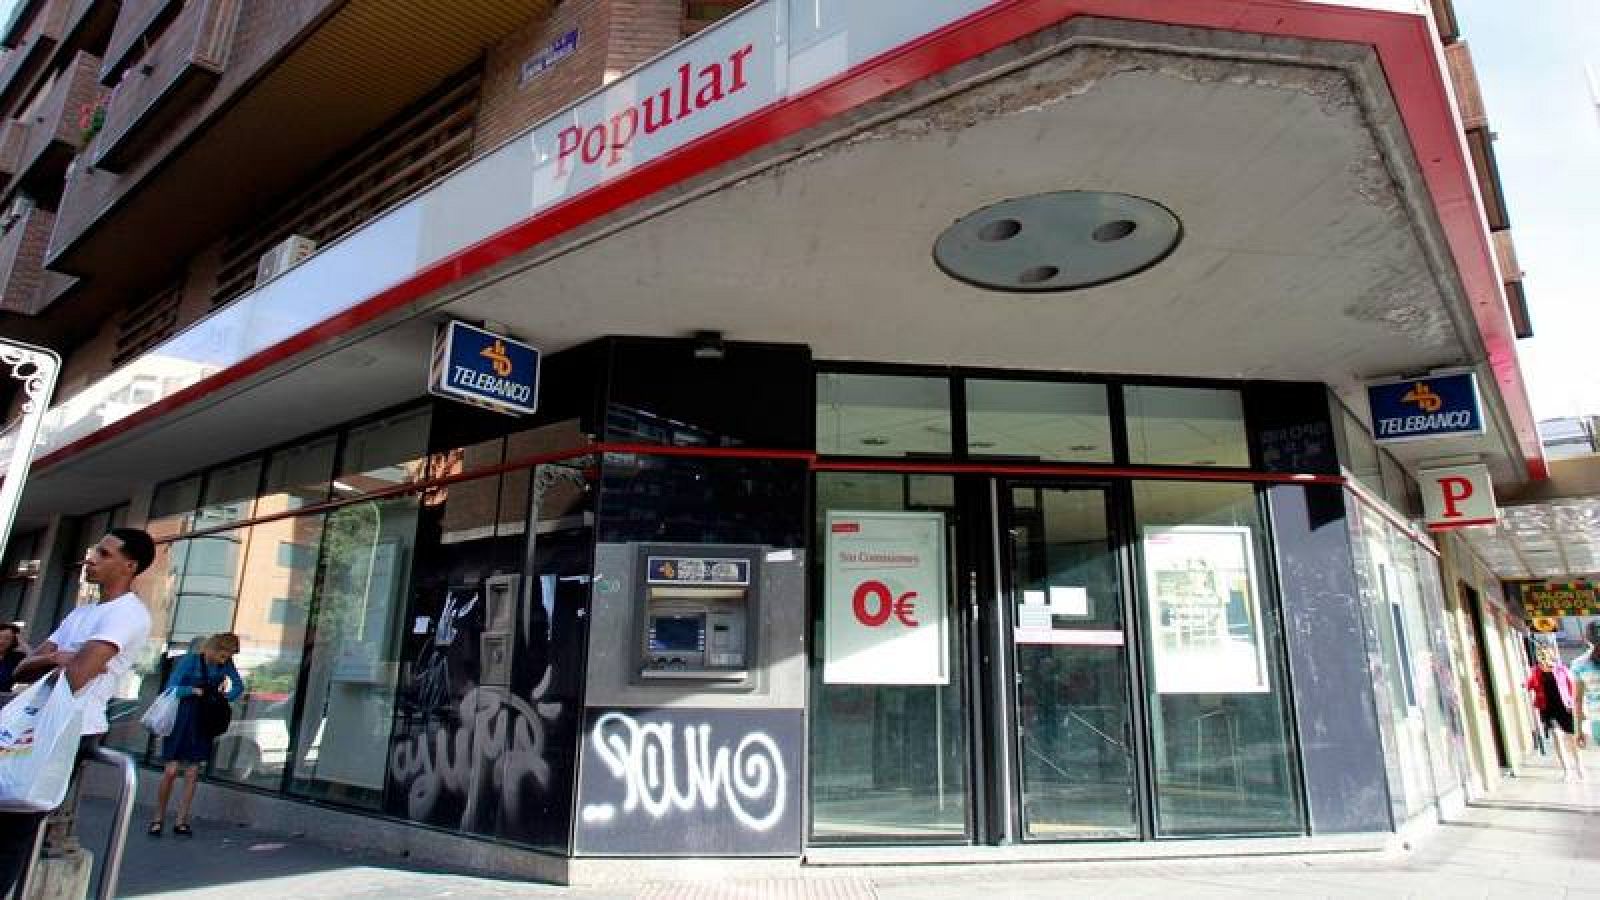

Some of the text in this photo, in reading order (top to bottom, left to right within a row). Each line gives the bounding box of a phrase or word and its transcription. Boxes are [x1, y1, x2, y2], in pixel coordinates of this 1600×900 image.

[554, 43, 753, 178] Popular
[453, 365, 531, 403] TELEBANCO
[1378, 409, 1471, 434] TELEBANCO
[1437, 476, 1473, 518] P
[852, 579, 920, 628] 0€
